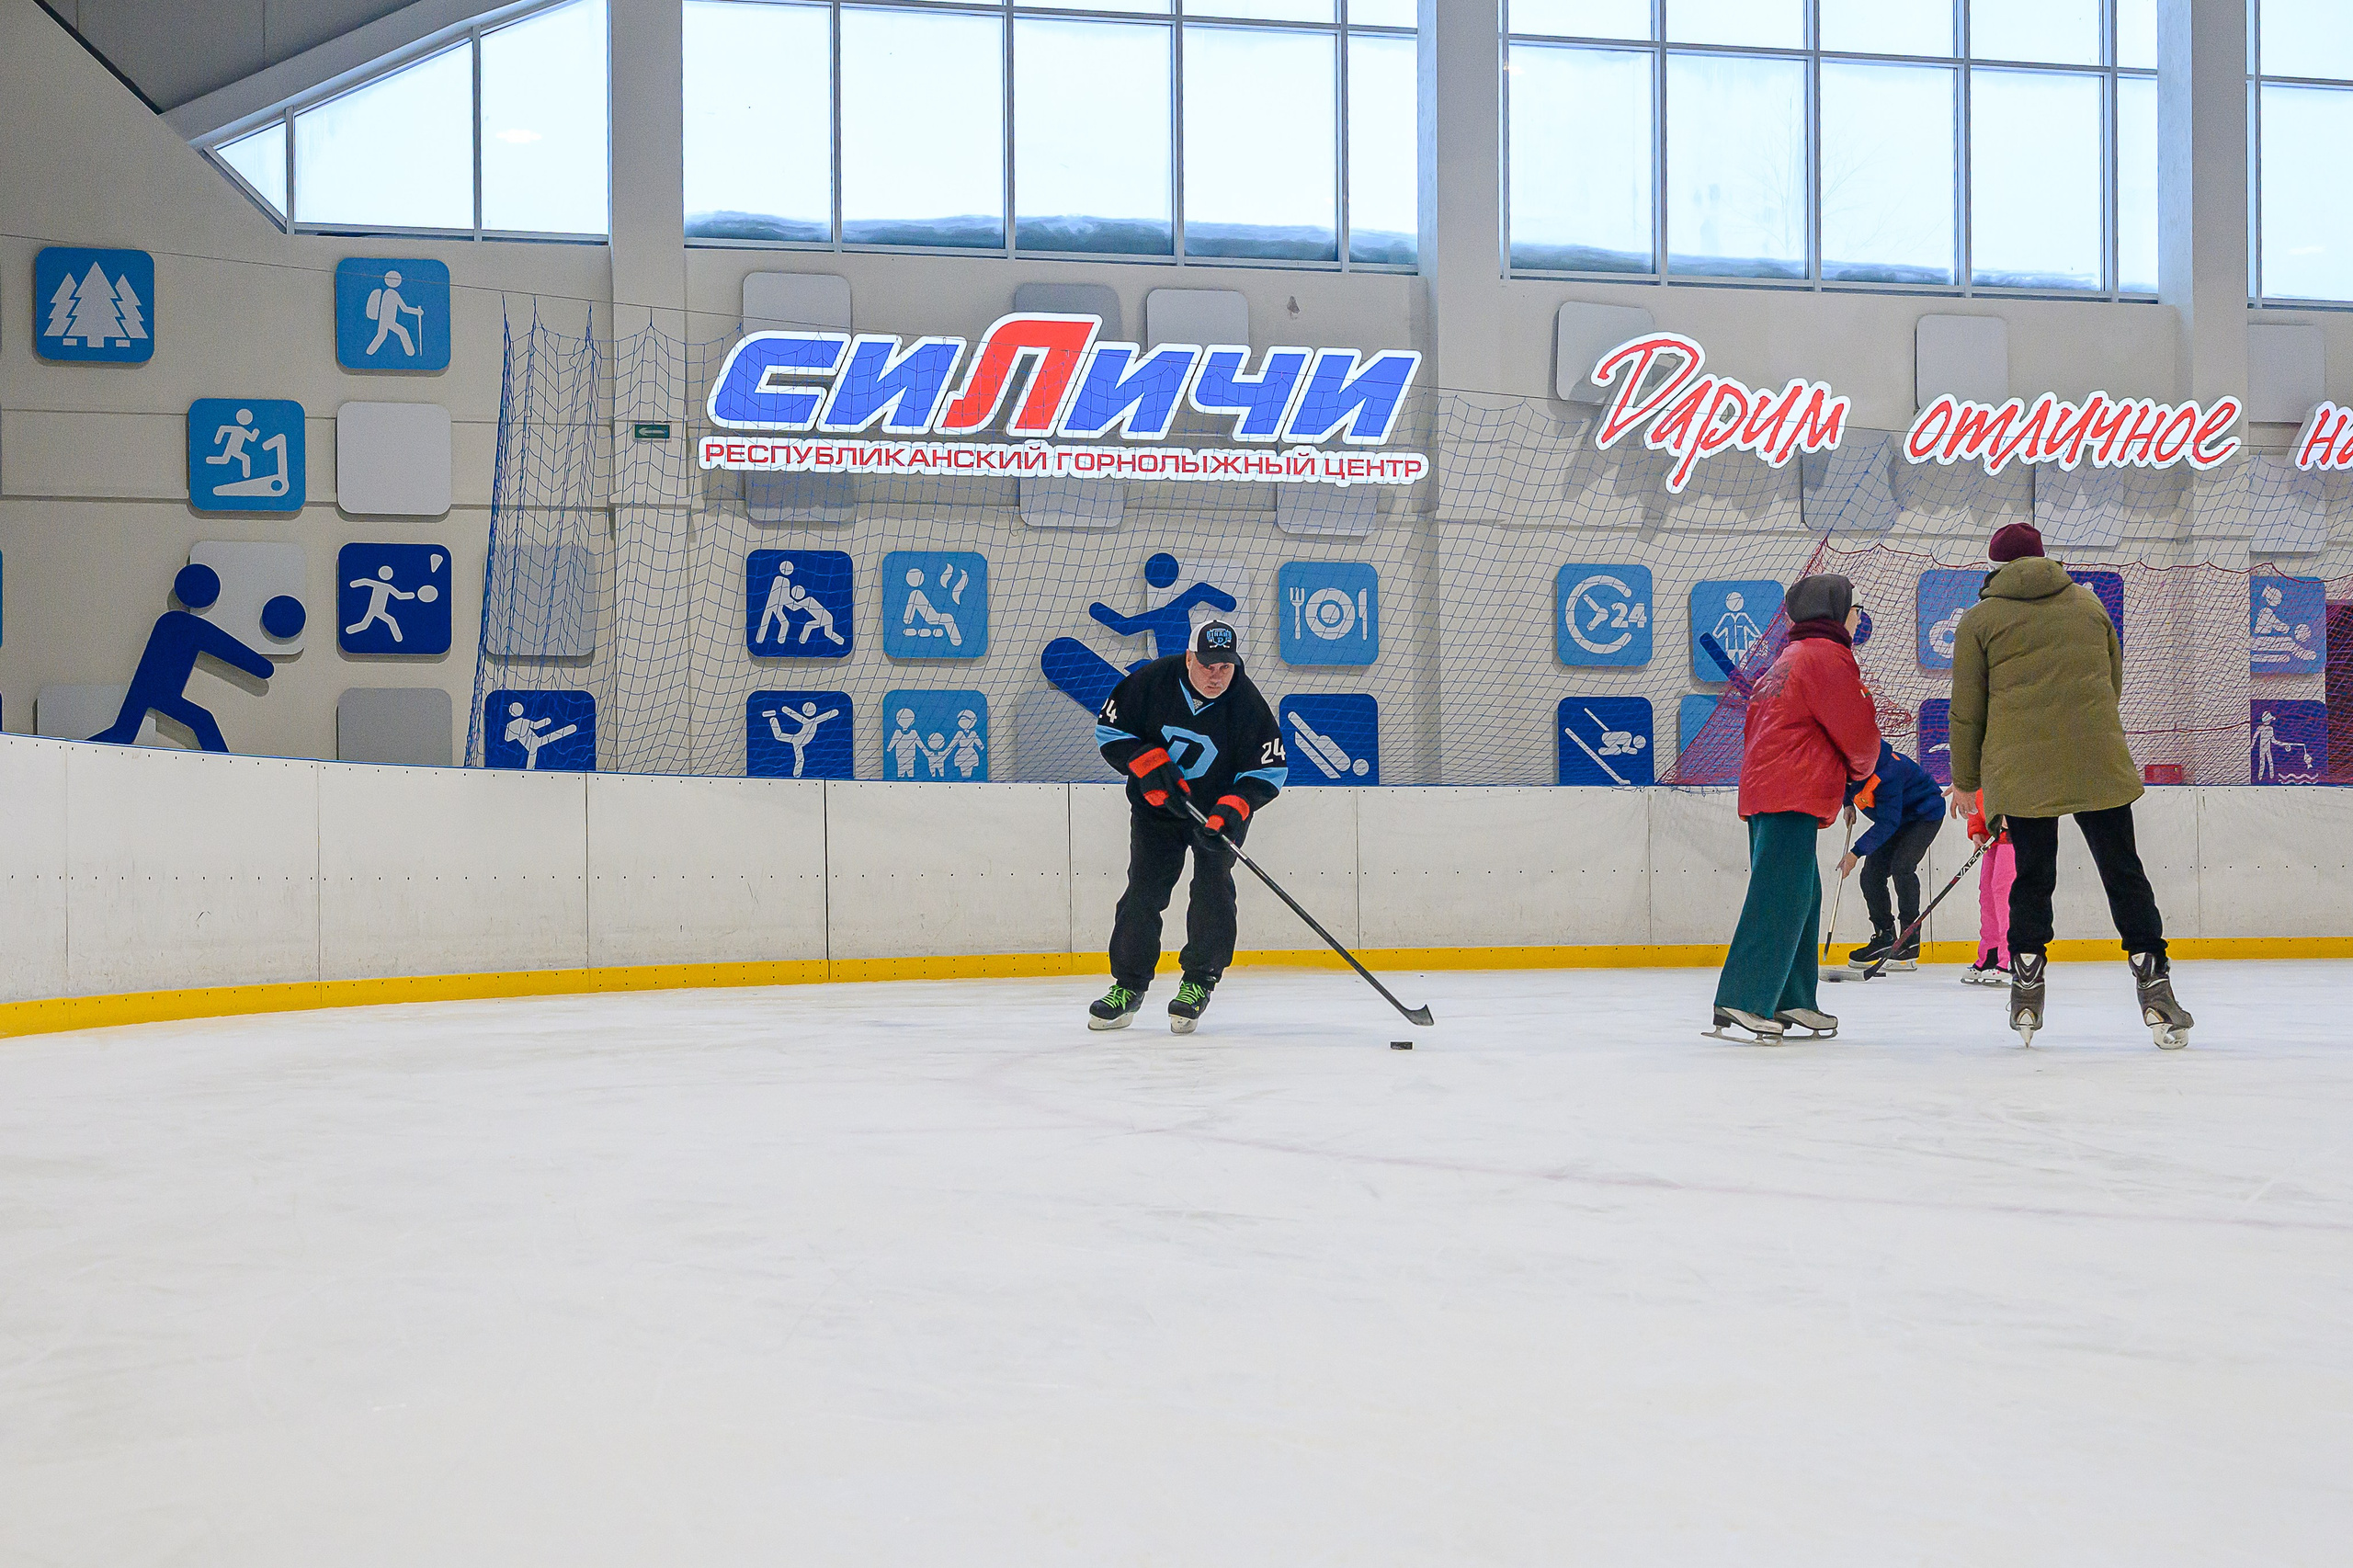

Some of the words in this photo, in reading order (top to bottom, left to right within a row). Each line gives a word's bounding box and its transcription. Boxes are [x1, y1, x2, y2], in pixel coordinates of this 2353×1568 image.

[1597, 338, 1845, 487] Дарим
[1909, 396, 2236, 470] отличное
[705, 443, 1047, 471] РЕСПУБЛИКАНСКИЙ
[1057, 451, 1315, 475] ГОРНОЛЫЖНЫЙ
[1324, 458, 1422, 479] ЦЕНТР
[1610, 602, 1647, 629] 24
[1160, 724, 1219, 780] D
[1260, 737, 1286, 765] 24
